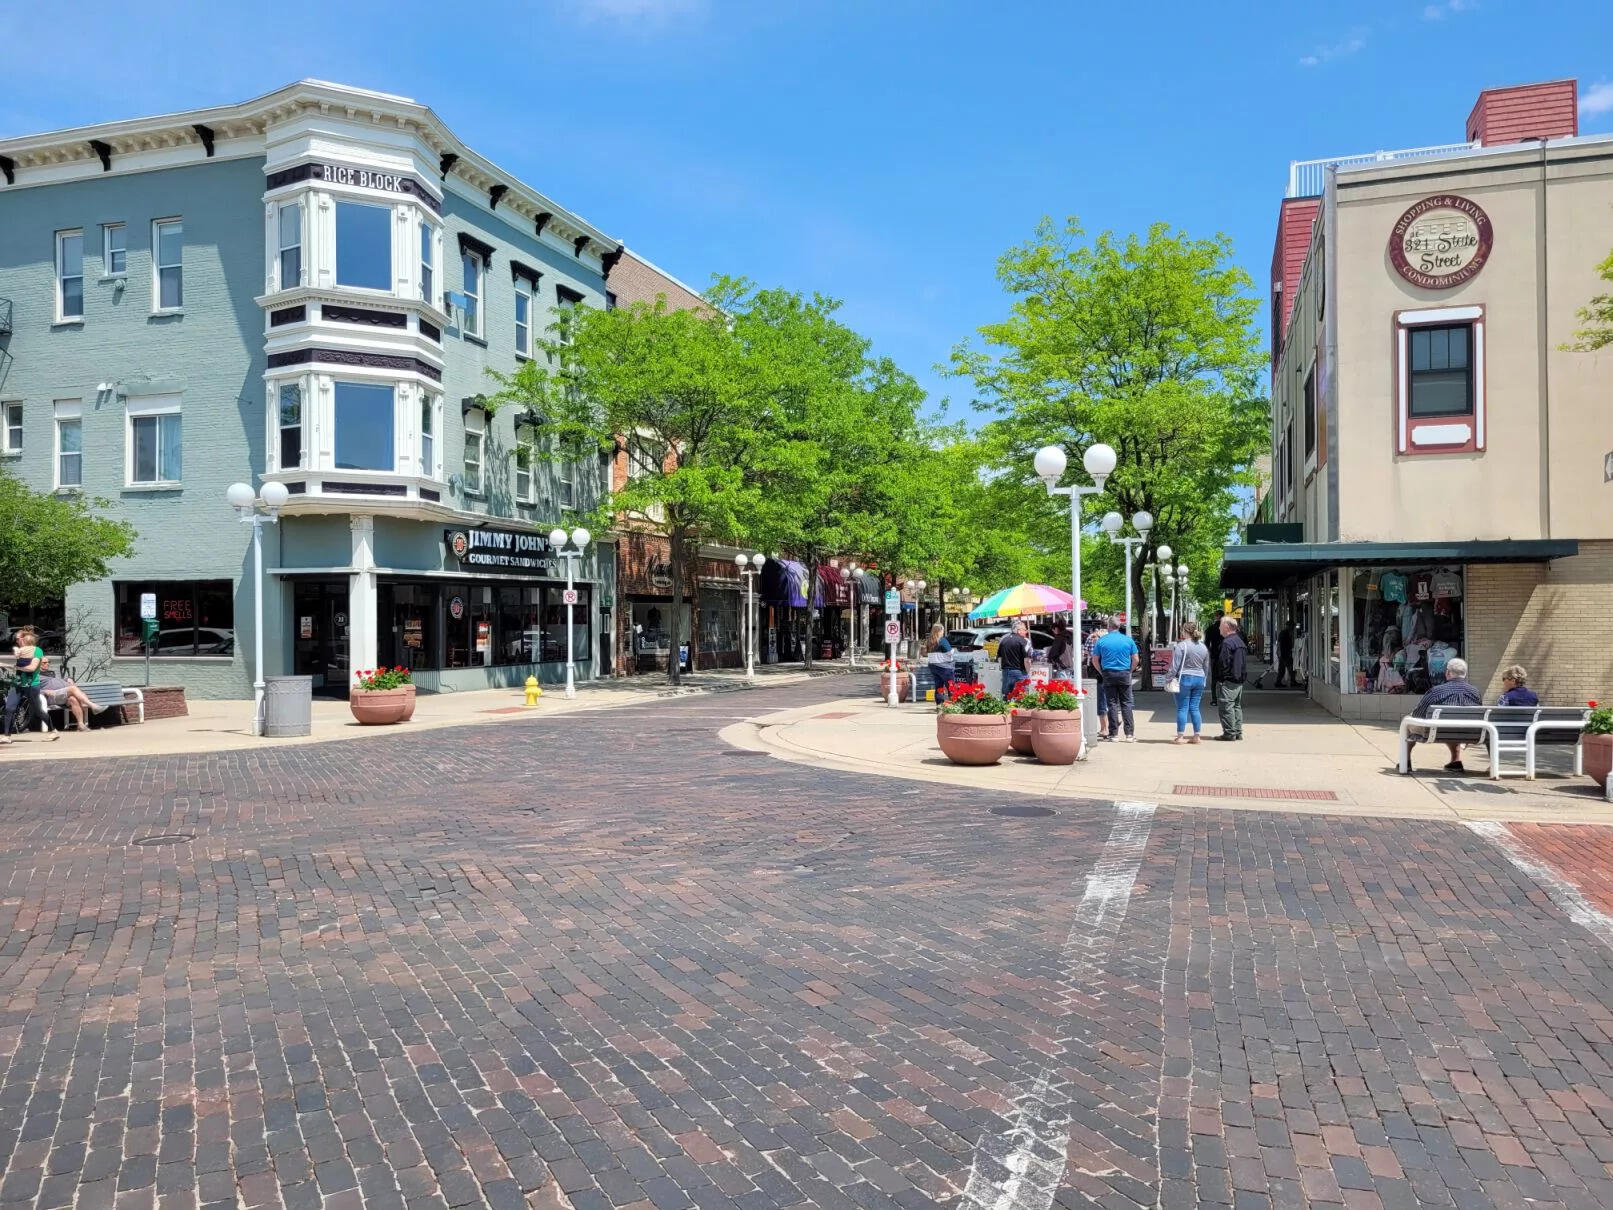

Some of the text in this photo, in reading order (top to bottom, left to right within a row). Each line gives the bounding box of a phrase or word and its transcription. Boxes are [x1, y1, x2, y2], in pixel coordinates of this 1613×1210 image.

[323, 165, 402, 192] RICE BLOCK
[1395, 197, 1486, 235] SHOPPING & LIVING
[1404, 232, 1477, 253] 321 State
[1402, 257, 1482, 286] CONDOMINIUMS
[1420, 253, 1462, 273] Street
[468, 529, 513, 549] JIMMY
[469, 553, 557, 569] GOURMET SANDWICHES
[163, 600, 191, 611] FREE
[163, 609, 192, 619] SMELLS
